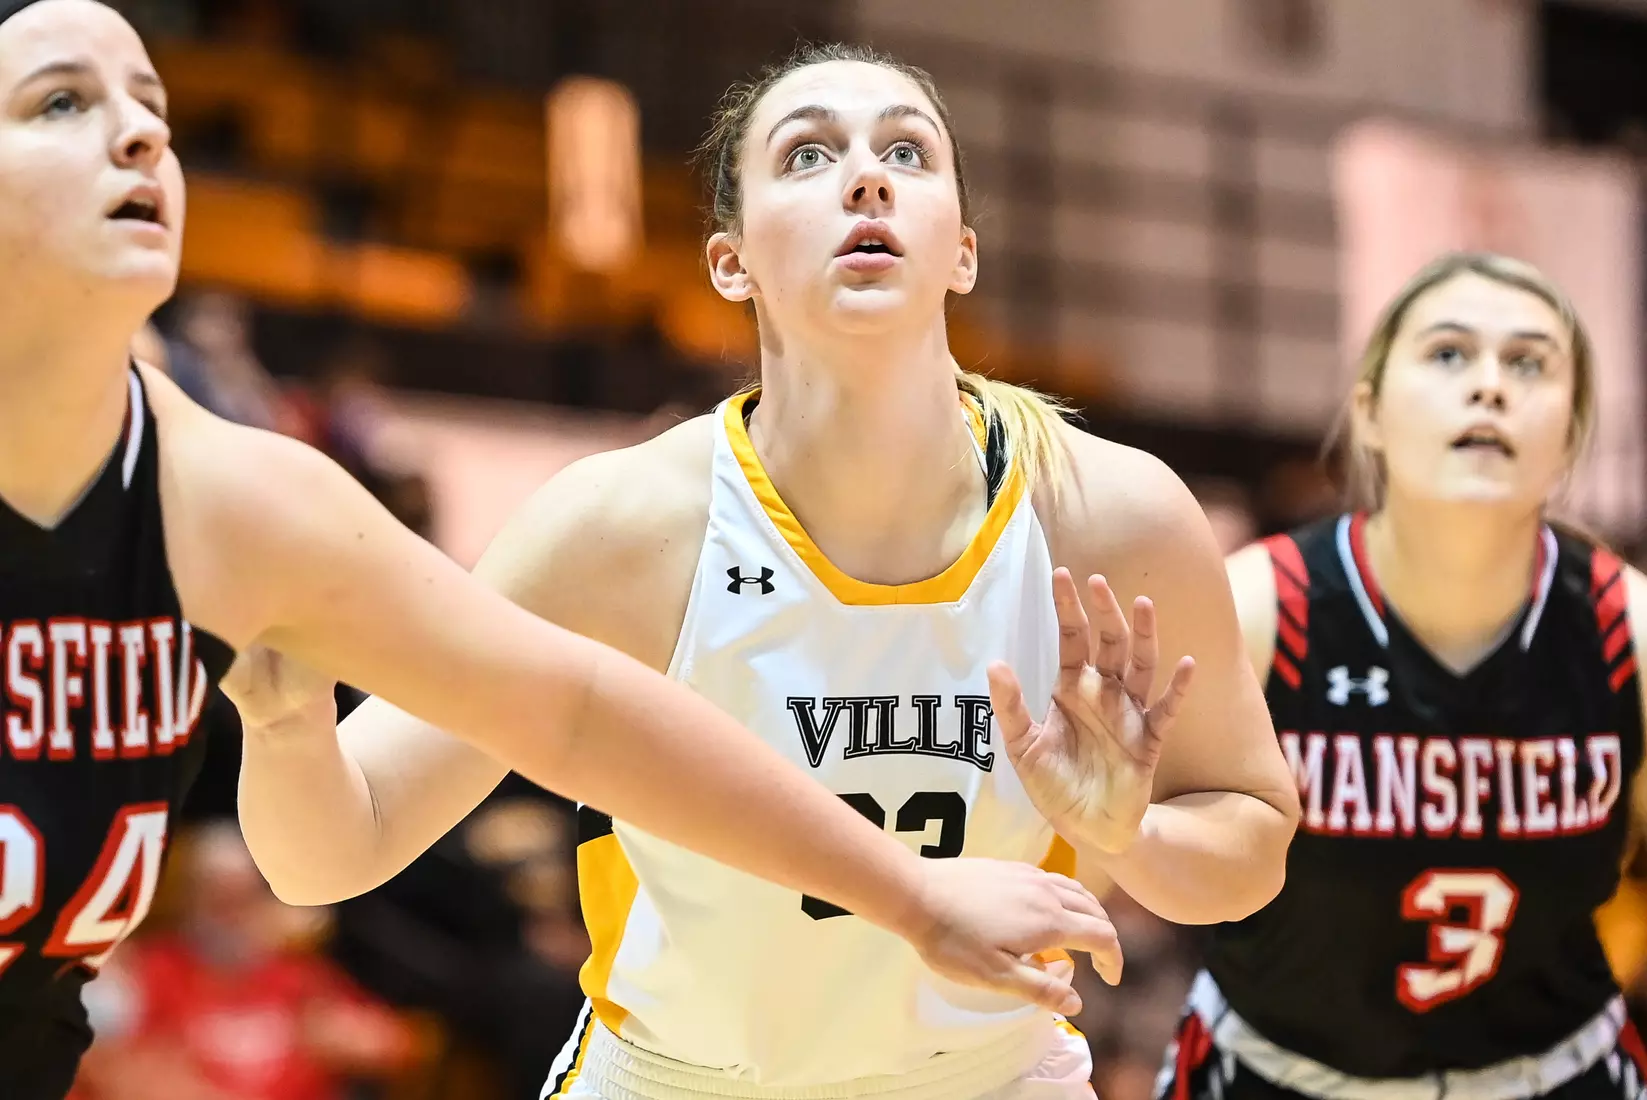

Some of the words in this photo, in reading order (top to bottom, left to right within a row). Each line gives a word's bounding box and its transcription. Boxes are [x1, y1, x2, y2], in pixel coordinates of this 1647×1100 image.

[0, 616, 208, 762] SFIELD
[787, 694, 995, 773] VILLE
[1278, 731, 1622, 838] MANSFIELD
[801, 791, 967, 921] 3
[1397, 867, 1521, 1014] 3
